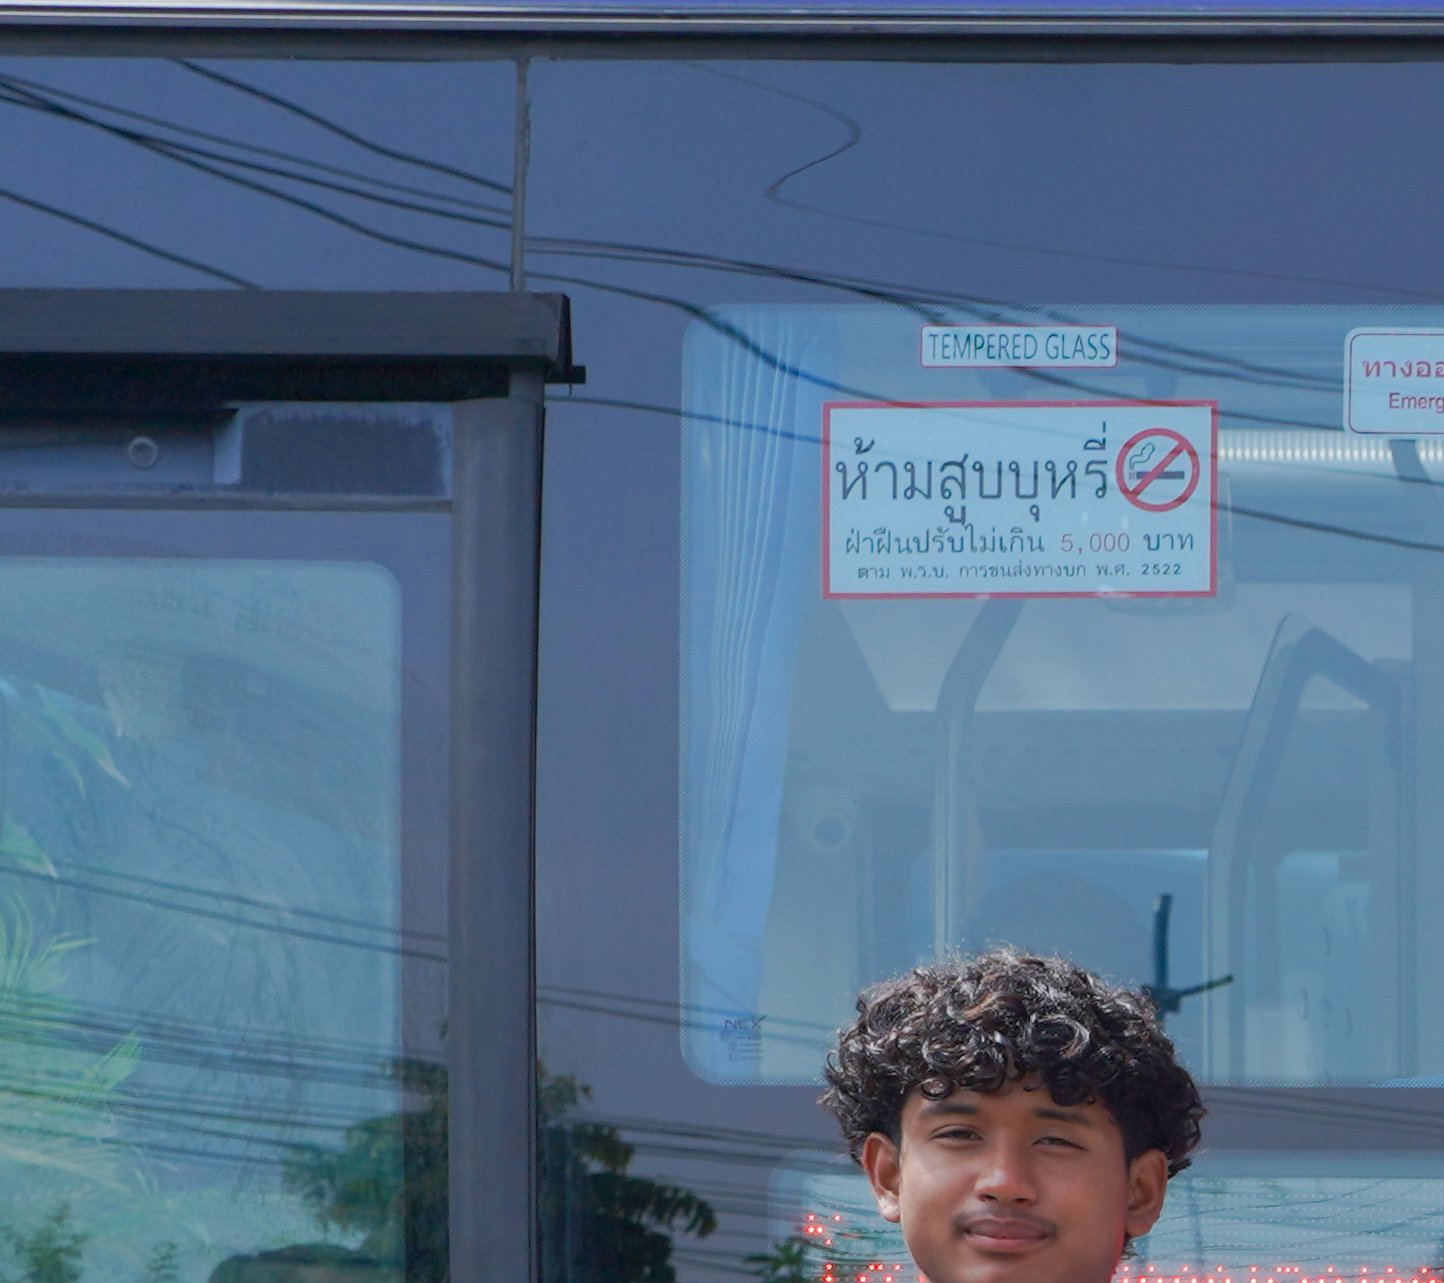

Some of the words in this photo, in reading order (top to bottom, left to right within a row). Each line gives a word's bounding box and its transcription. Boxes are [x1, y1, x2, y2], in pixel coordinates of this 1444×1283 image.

[928, 333, 1038, 360] TEMPERED
[1045, 333, 1110, 360] GLASS
[834, 422, 1109, 524] ห้ามสูบบุหรี่
[845, 523, 1045, 555] ฝ่าฝืนปรับไม่เกิน
[1059, 531, 1133, 559] 5,000
[1143, 529, 1196, 555] บาท
[1140, 562, 1183, 578] 2522
